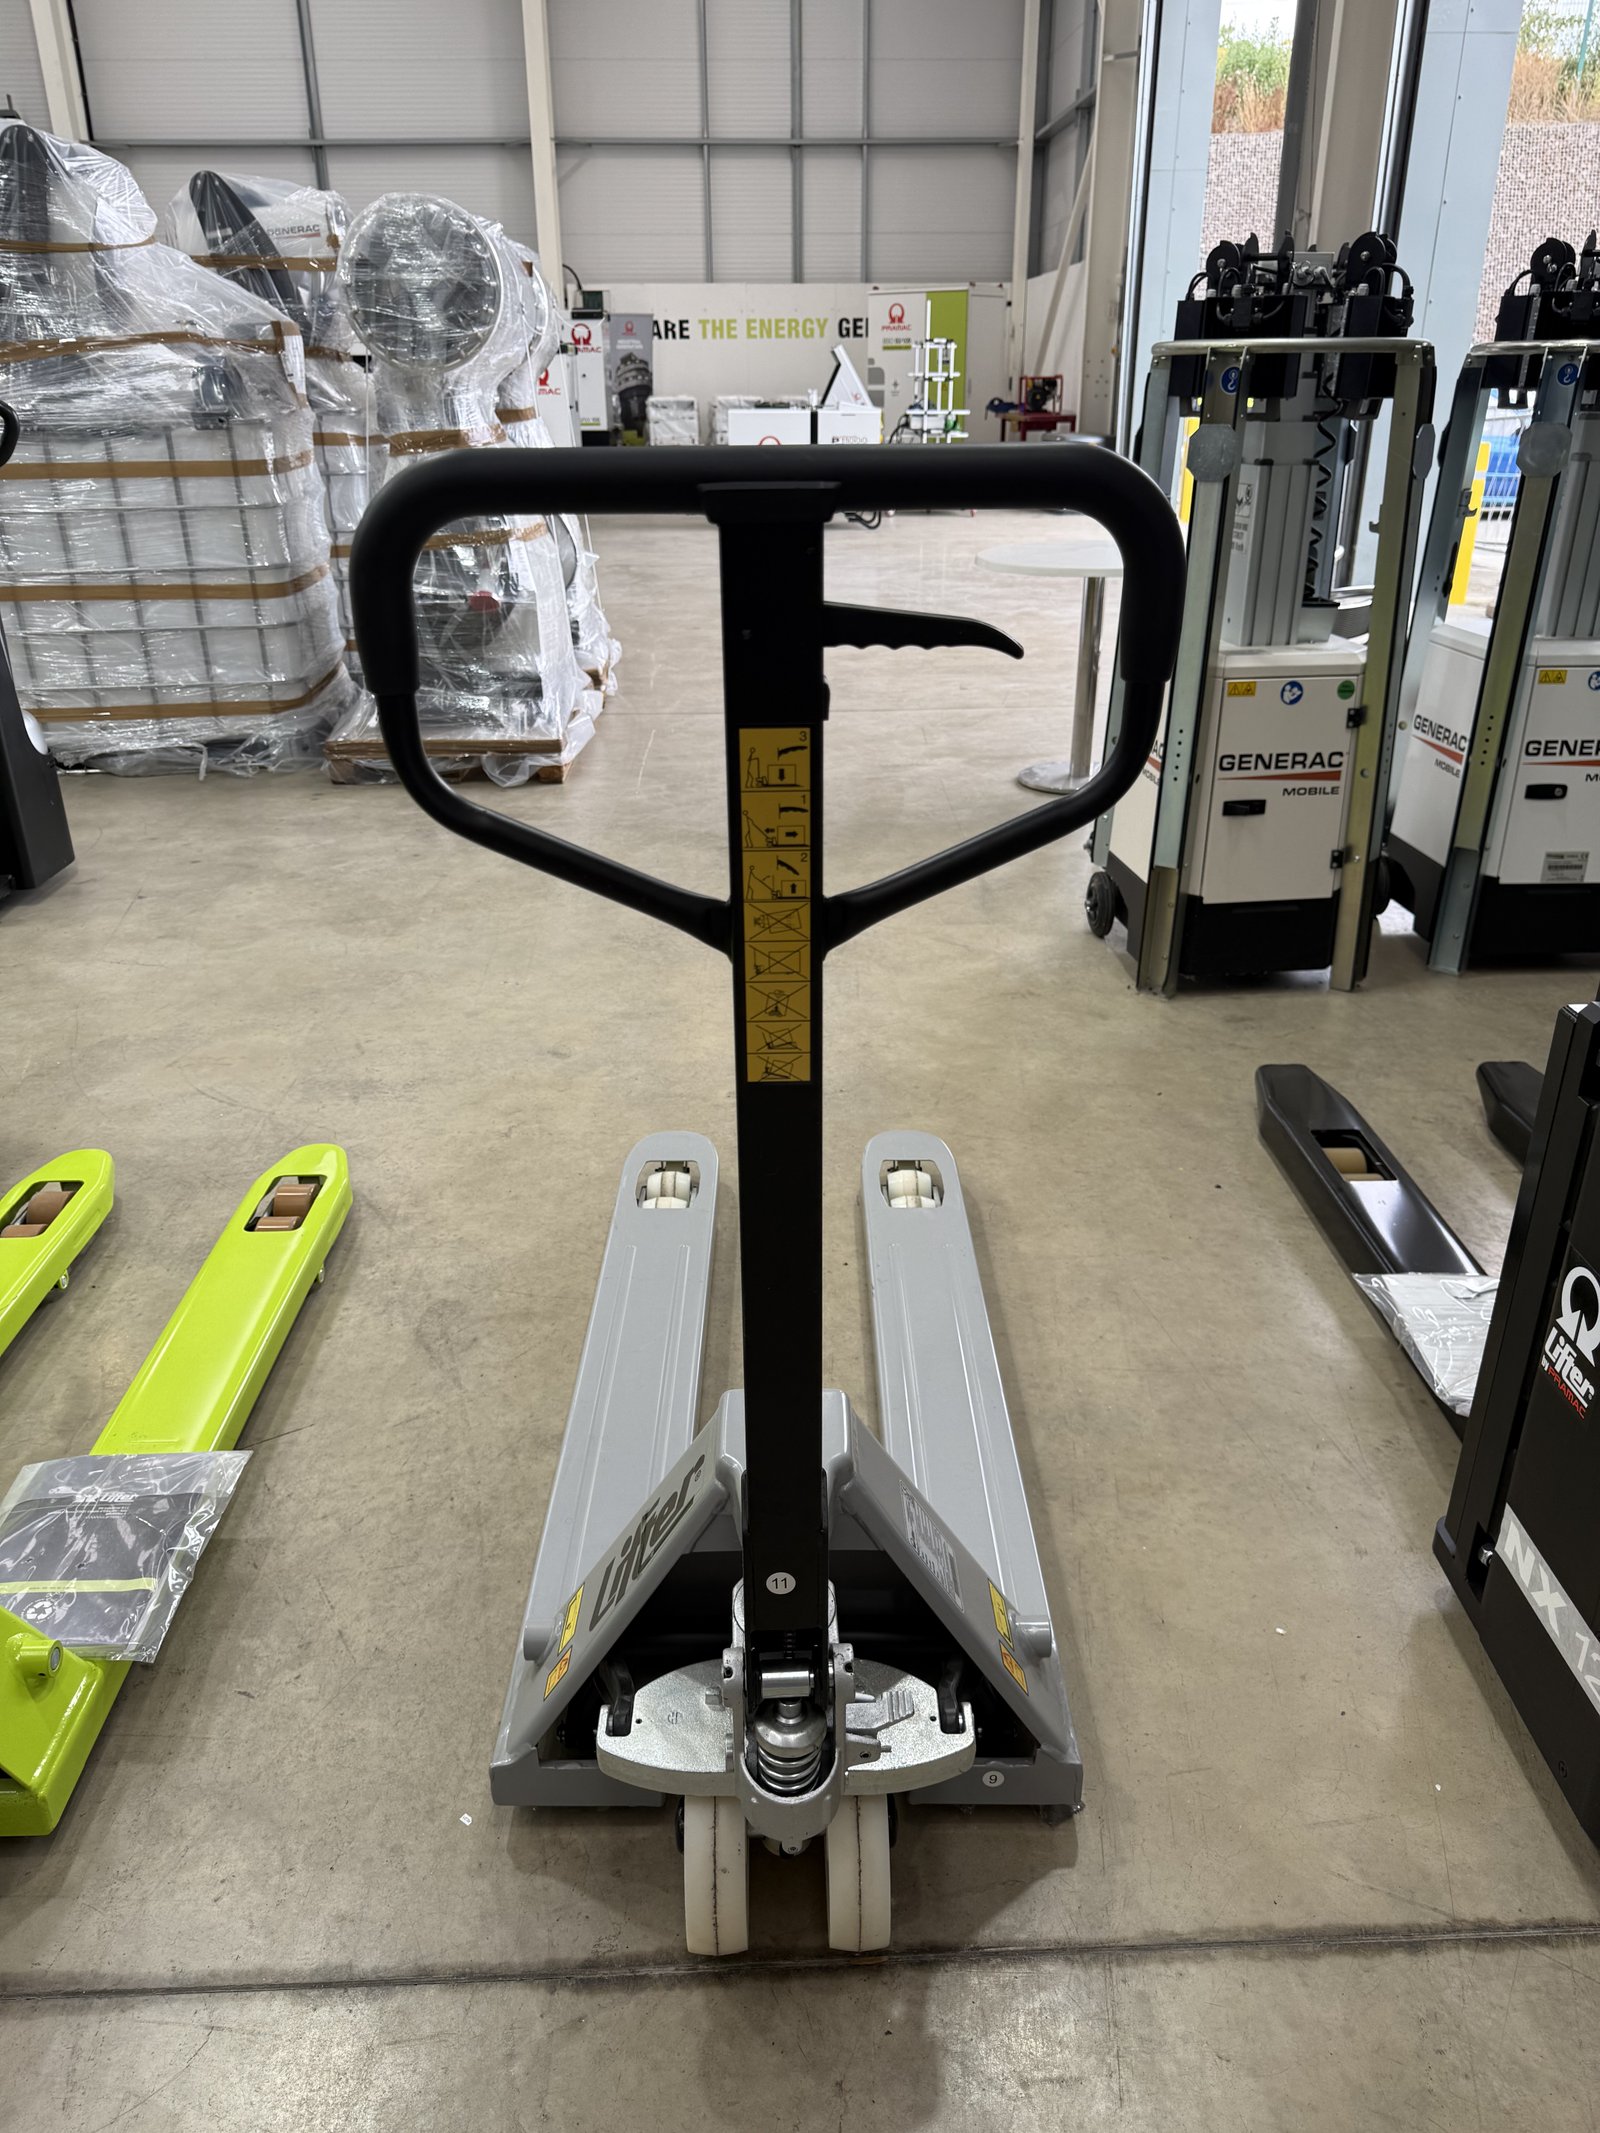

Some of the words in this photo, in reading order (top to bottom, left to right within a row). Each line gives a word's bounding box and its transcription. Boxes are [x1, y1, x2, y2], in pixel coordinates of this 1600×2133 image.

[653, 319, 690, 340] ARE
[699, 319, 738, 340] THE
[746, 318, 829, 340] ENERGY
[838, 317, 868, 339] GE
[799, 731, 807, 742] 3
[1414, 714, 1468, 752] GENERAC
[1219, 752, 1344, 771] GENERAC
[1434, 758, 1461, 778] MOBILE
[801, 794, 806, 805] 1
[1282, 786, 1340, 797] MOBILE
[800, 853, 808, 862] 2
[1545, 1326, 1595, 1408] Lifter
[1547, 1366, 1586, 1419] PRAMAC
[589, 1454, 705, 1632] Lifter
[771, 1577, 787, 1589] 11
[1504, 1520, 1567, 1638] NX
[989, 1774, 998, 1784] 9
